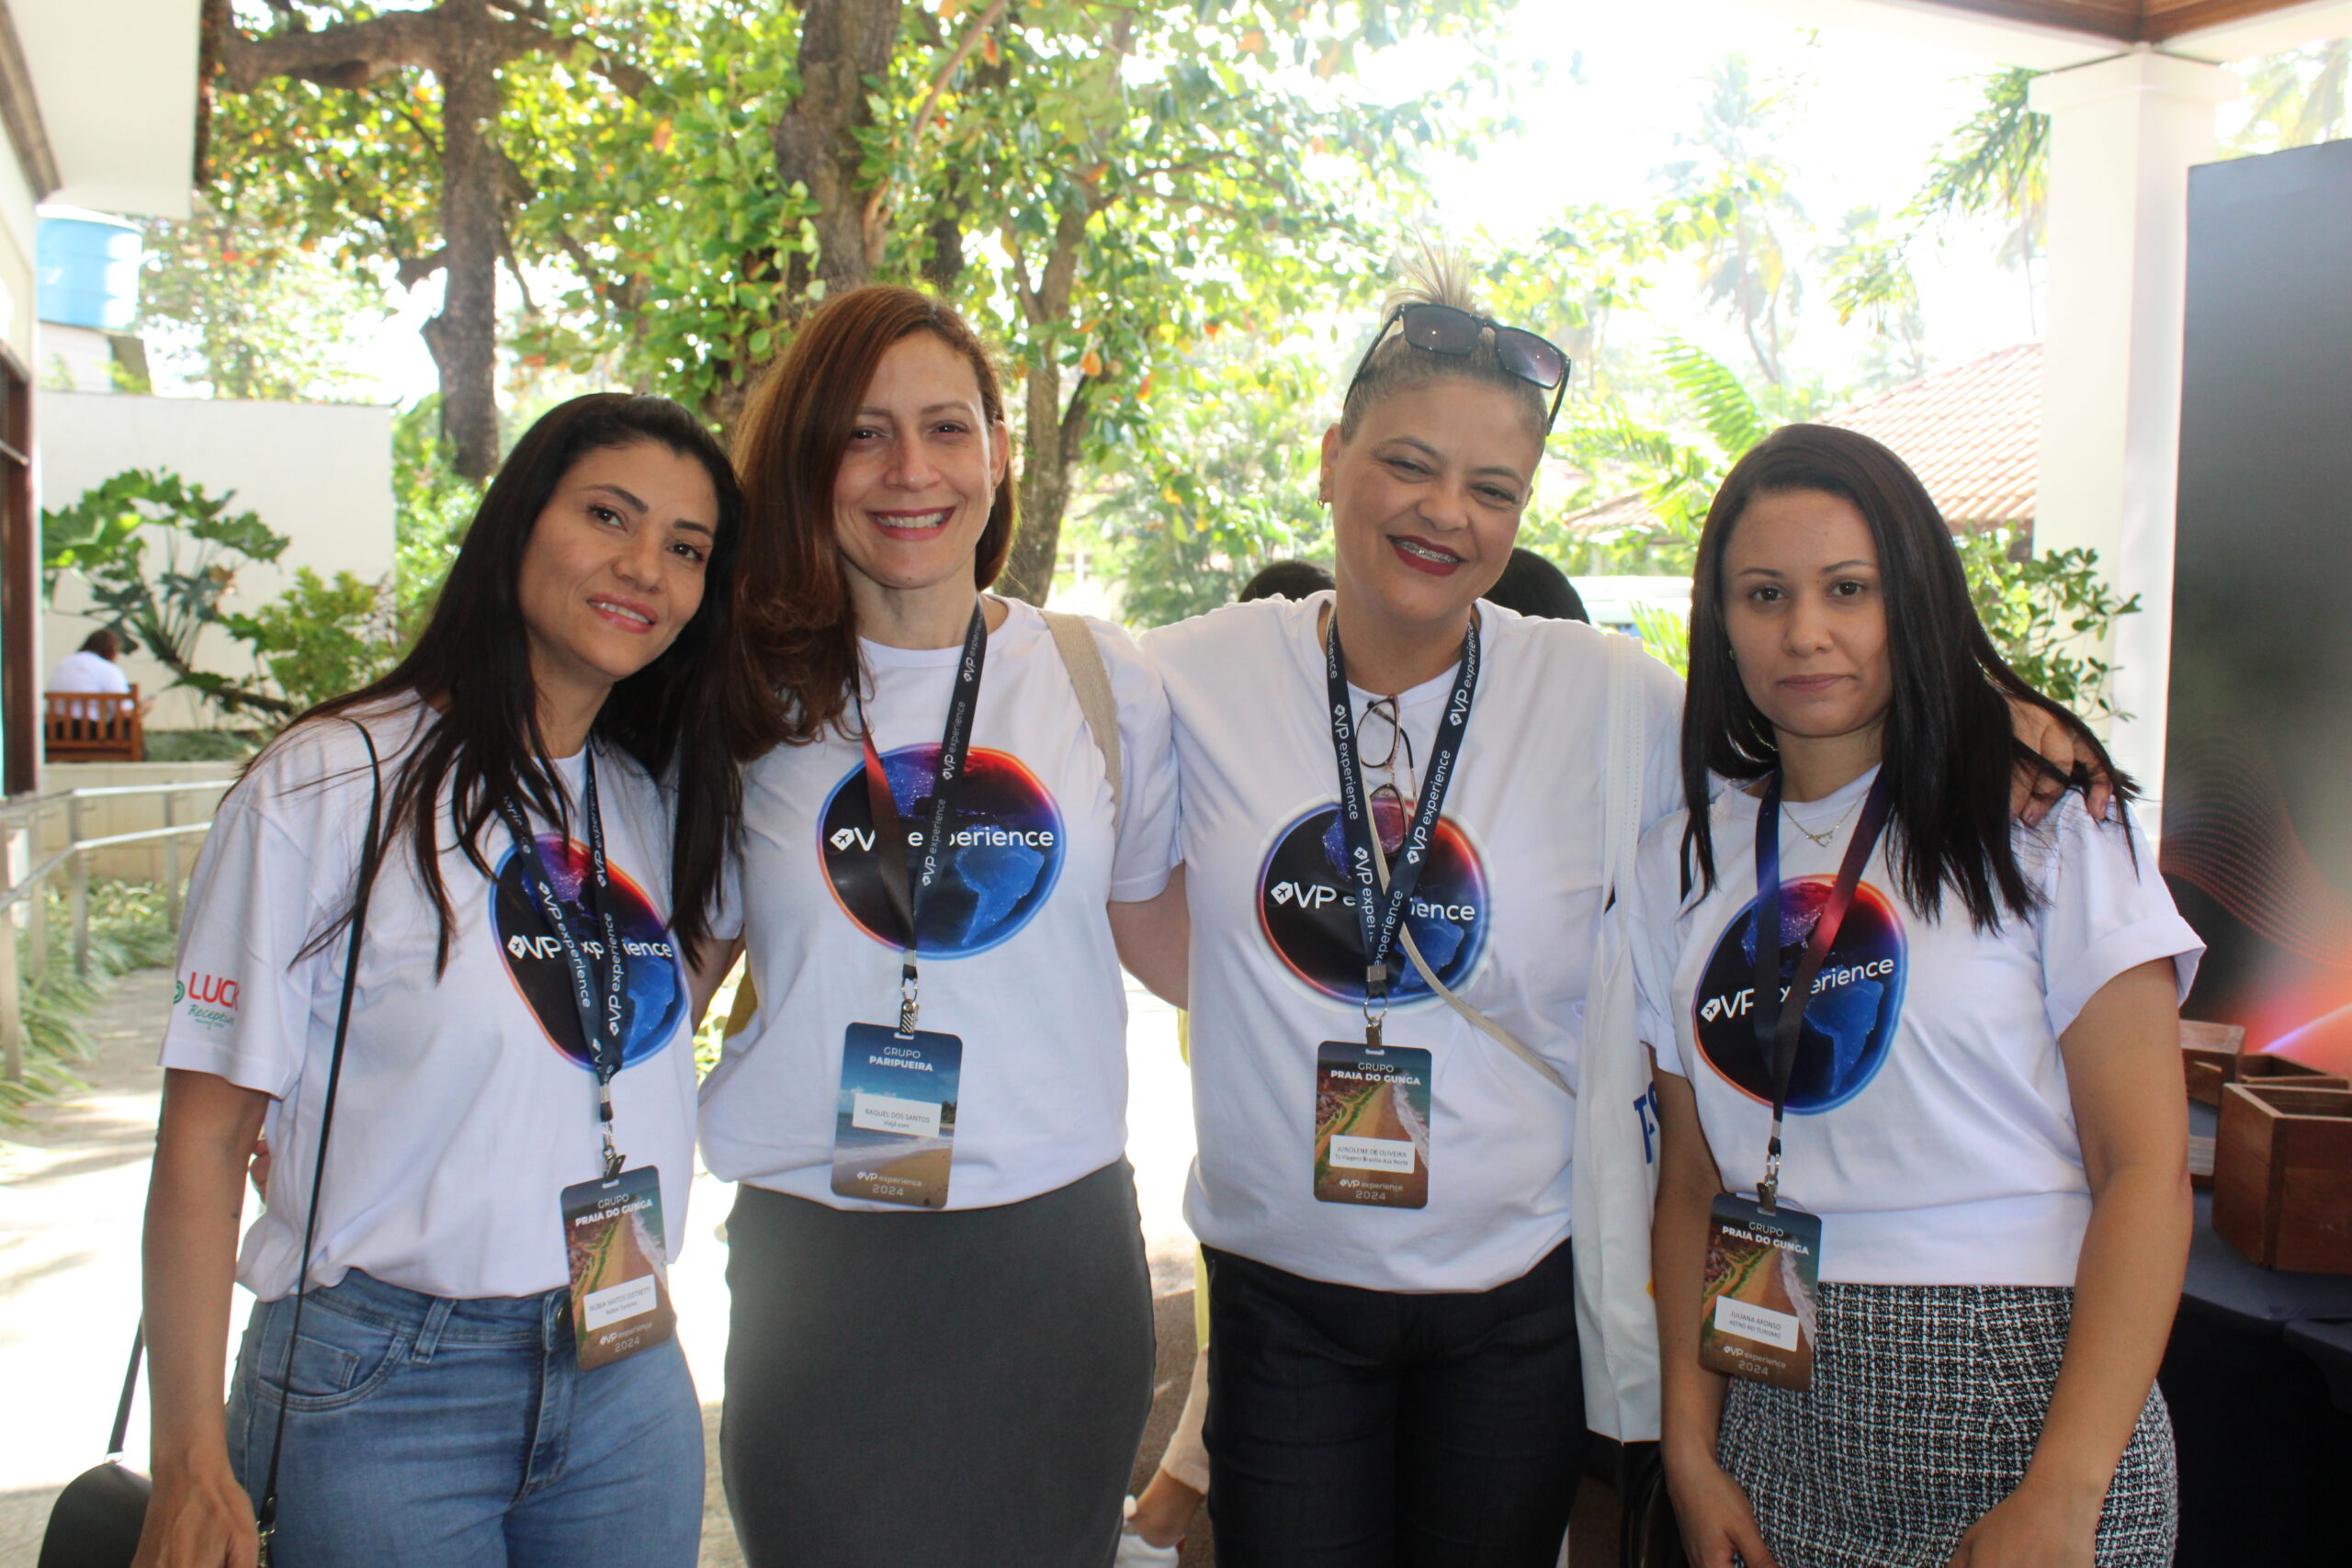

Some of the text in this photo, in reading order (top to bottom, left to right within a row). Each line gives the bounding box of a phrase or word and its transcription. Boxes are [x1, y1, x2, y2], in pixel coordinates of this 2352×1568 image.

[965, 657, 975, 674] VP
[1454, 622, 1475, 708] VP experience
[944, 701, 966, 772] VP experience
[1335, 715, 1358, 820] VP experience
[1409, 750, 1451, 851] VP experience
[854, 827, 876, 852] V
[925, 798, 946, 876] VP experience
[594, 850, 605, 874] VP
[1355, 859, 1374, 886] VP
[1294, 882, 1337, 908] VP
[522, 935, 562, 959] VP
[543, 893, 591, 1008] VP experience
[605, 912, 625, 1022] VP experience
[883, 1046, 921, 1059] GRUPO
[868, 1055, 933, 1072] PARIPUEIRA
[1358, 1062, 1394, 1073] GRUPO
[1330, 1069, 1421, 1086] PRAIA DO GUNGA
[865, 1108, 930, 1123] RAQUEL DOS SANTOS
[1370, 1147, 1378, 1156] DE
[1380, 1149, 1407, 1158] OLIVEIRA
[865, 1172, 922, 1187] VP experience
[1346, 1179, 1404, 1192] VP experience
[873, 1183, 904, 1196] 2024
[1355, 1190, 1386, 1201] 2024
[597, 1194, 629, 1209] GRUPO
[575, 1199, 653, 1227] PRAIA DO GUNGA
[1748, 1222, 1783, 1236] GRUPO
[1722, 1225, 1809, 1255] PRAIA DO GUNGA
[1731, 1311, 1781, 1330] JULIANA AFONSO
[615, 1336, 641, 1353] 2024
[1730, 1347, 1786, 1369] VP experience
[1738, 1359, 1769, 1375] 2024
